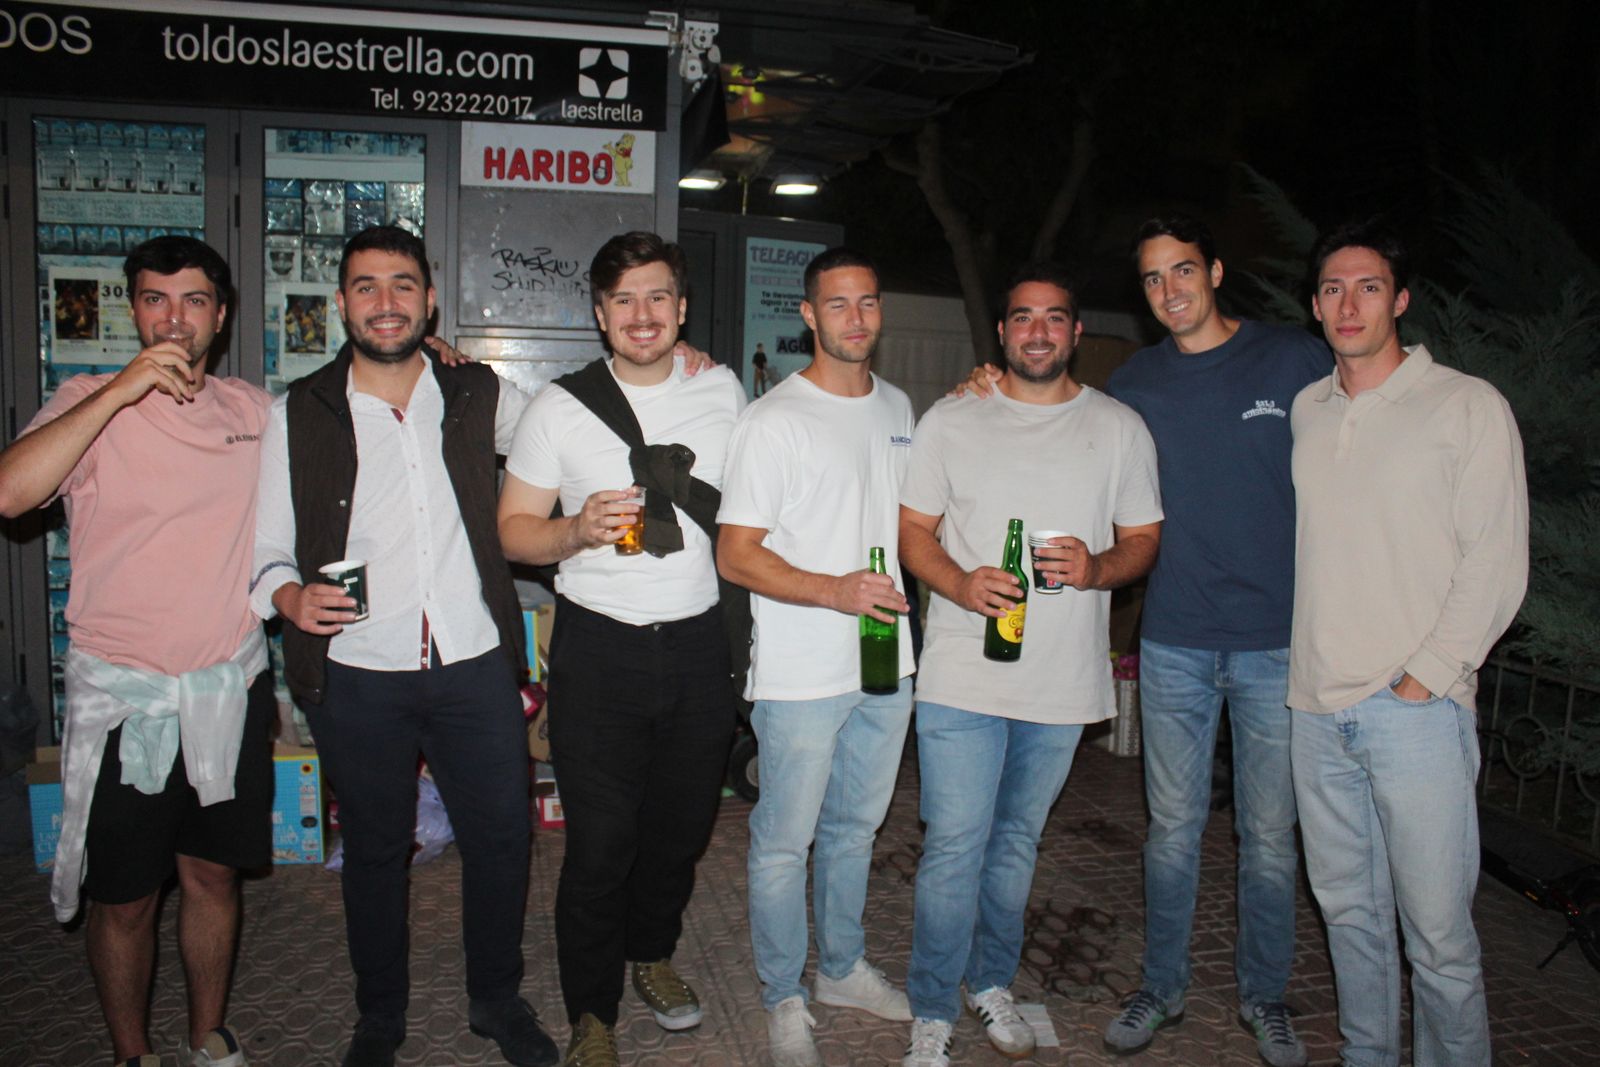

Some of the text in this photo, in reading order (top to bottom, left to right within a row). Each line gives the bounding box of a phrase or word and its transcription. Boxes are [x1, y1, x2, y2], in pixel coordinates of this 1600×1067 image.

[162, 23, 534, 80] toldoslaestrella.com
[370, 88, 533, 117] Tel. 923222017
[561, 99, 643, 123] laestrella
[483, 146, 613, 185] HARIBO
[751, 247, 815, 266] TELEAGU
[102, 286, 130, 298] 30
